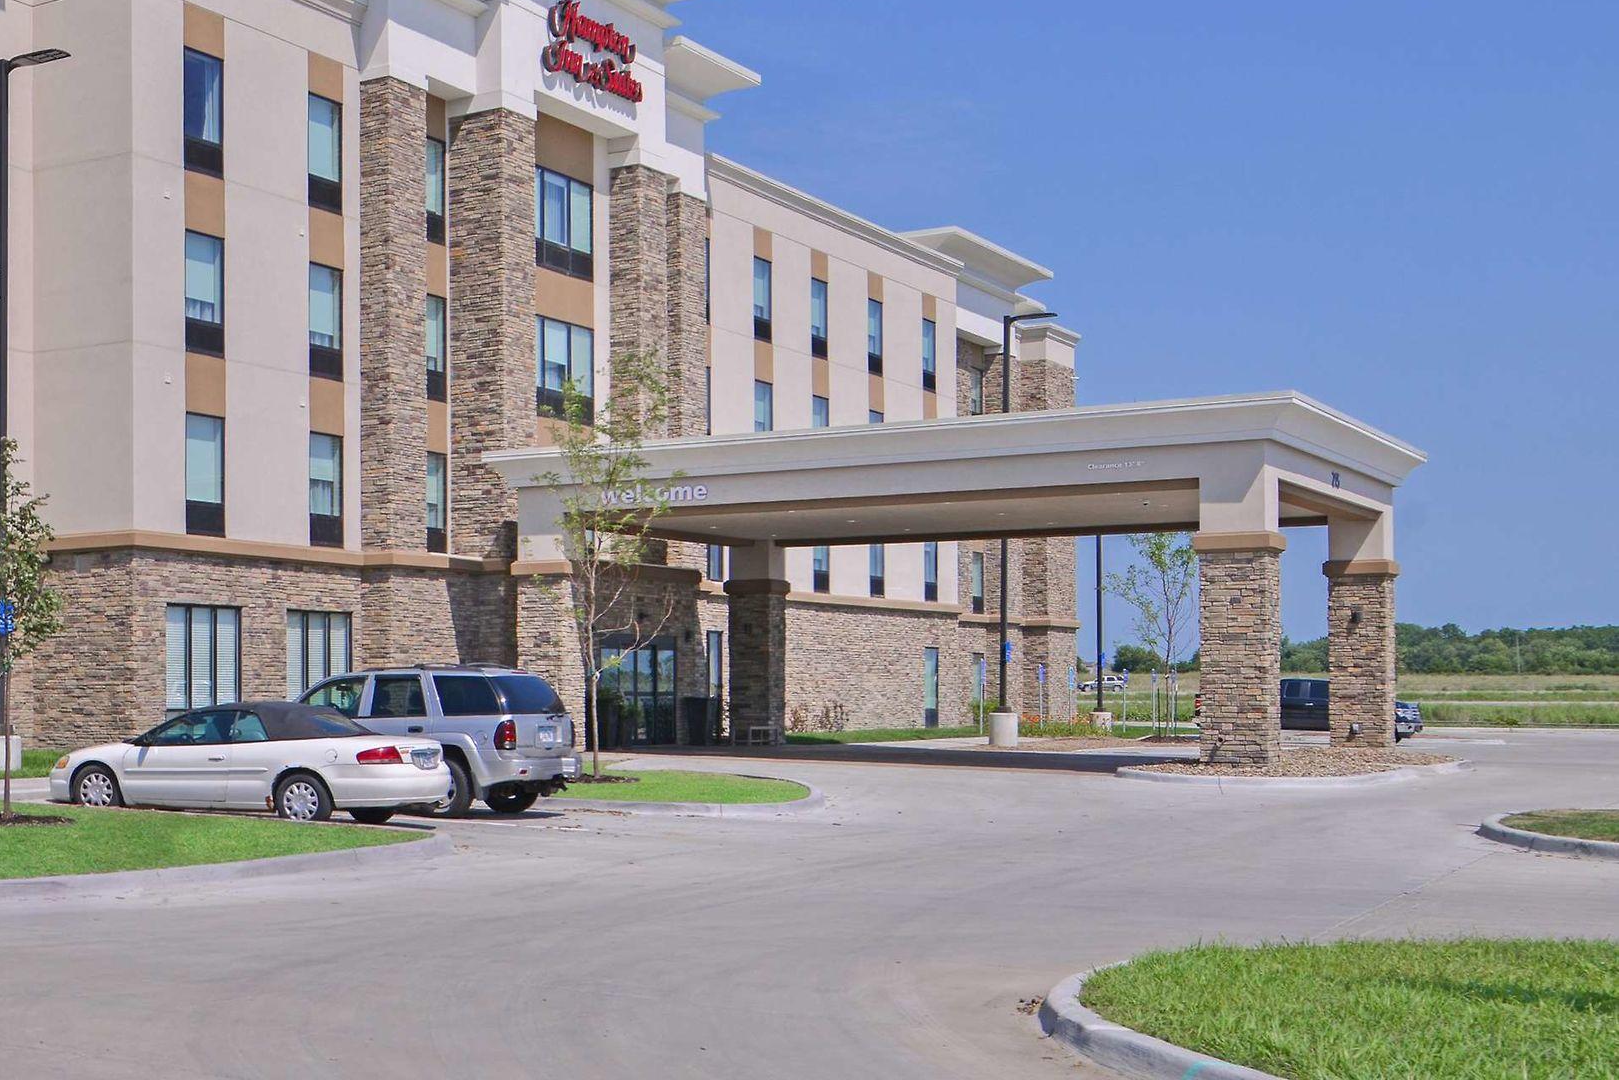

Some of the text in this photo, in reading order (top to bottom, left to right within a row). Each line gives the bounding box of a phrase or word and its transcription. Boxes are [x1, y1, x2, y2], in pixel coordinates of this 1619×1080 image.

[547, 0, 637, 64] Hampton
[541, 40, 590, 83] Inn
[596, 58, 643, 102] Suites
